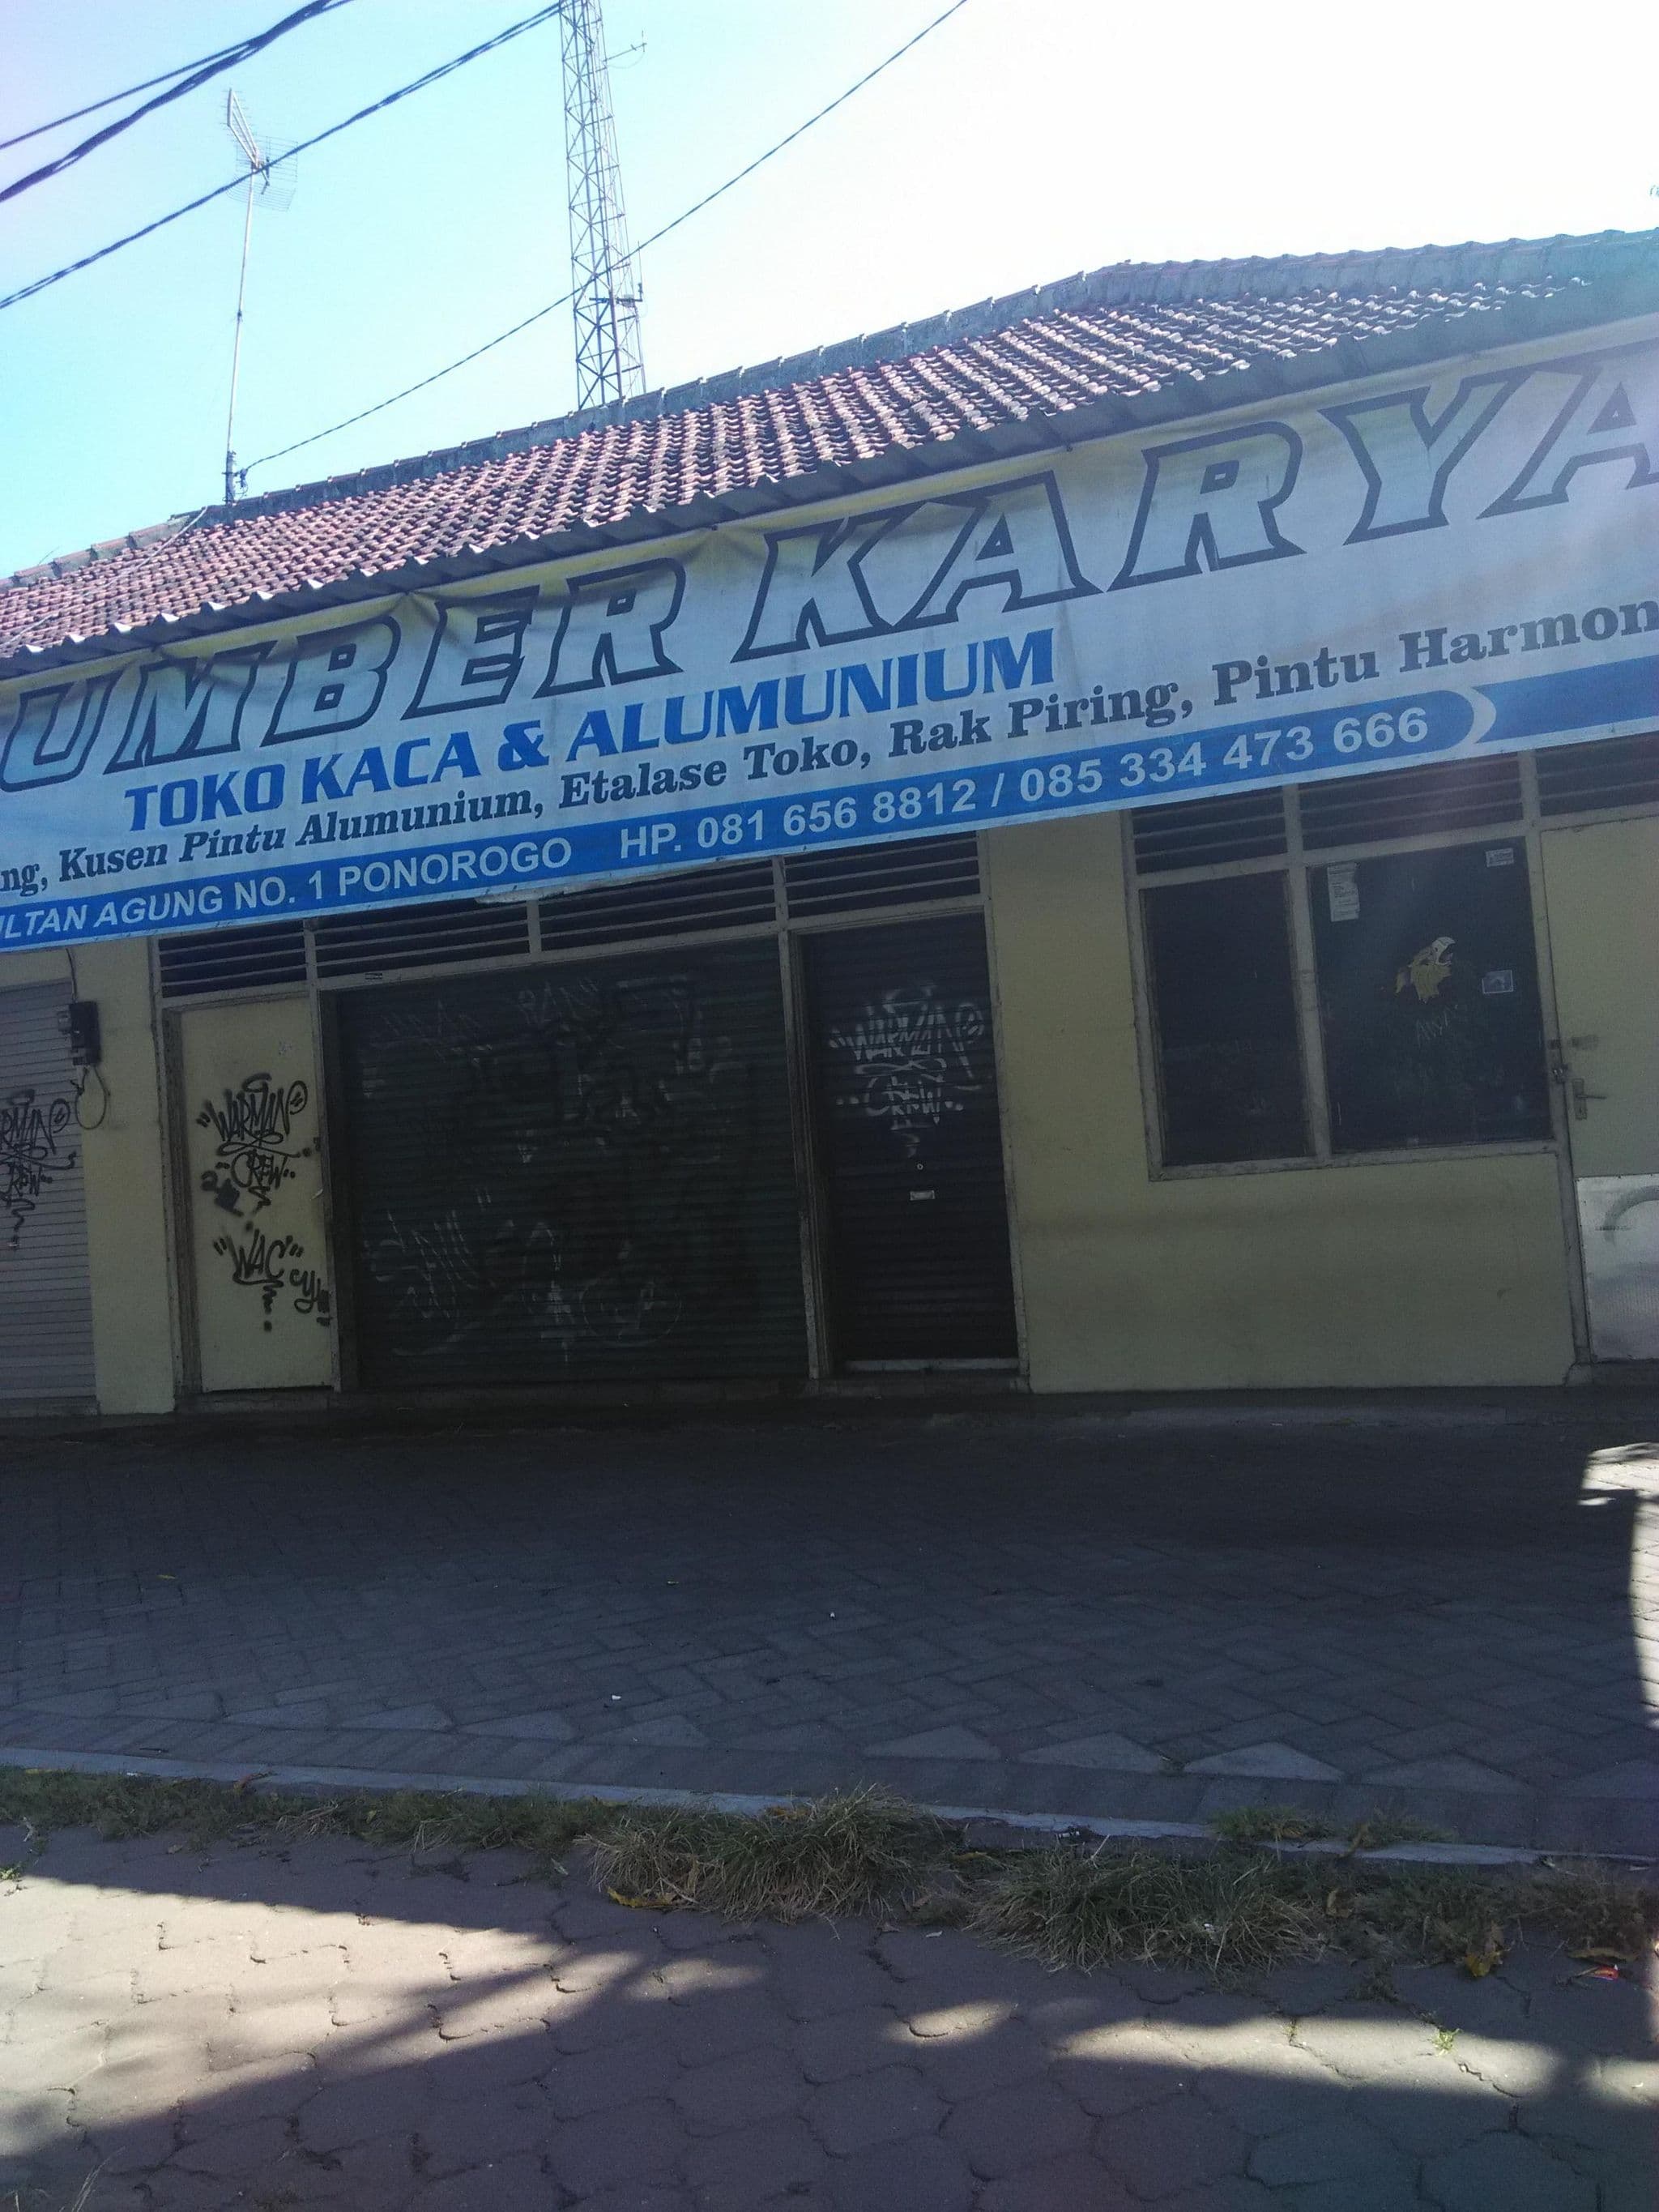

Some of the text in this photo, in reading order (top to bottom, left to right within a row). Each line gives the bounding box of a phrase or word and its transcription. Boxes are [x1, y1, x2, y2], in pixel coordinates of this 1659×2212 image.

[0, 337, 1659, 792] UMBER KARYA
[59, 843, 168, 882] Kusen
[178, 826, 284, 863] Pintu
[296, 788, 544, 847] Alumunium,
[559, 758, 727, 809] Etalase
[743, 732, 871, 780] Toko,
[889, 708, 992, 758] Rak
[1008, 679, 1193, 739] Piring,
[1213, 645, 1380, 707] Pintu
[1399, 600, 1659, 673] Harmon
[93, 888, 223, 929] AGUNG
[235, 876, 296, 910] NO.
[309, 869, 323, 900] 1
[339, 836, 571, 896] PONOROGO
[620, 823, 681, 860] HP.
[697, 811, 766, 851] 081
[783, 796, 858, 837] 656
[872, 778, 977, 825] 8812
[992, 771, 1005, 809] /
[1020, 758, 1103, 803] 085
[1120, 741, 1207, 788] 334
[1223, 725, 1314, 771] 473
[1333, 707, 1429, 753] 666
[125, 627, 1054, 831] TOKO KACA & ALUMUNIUM
